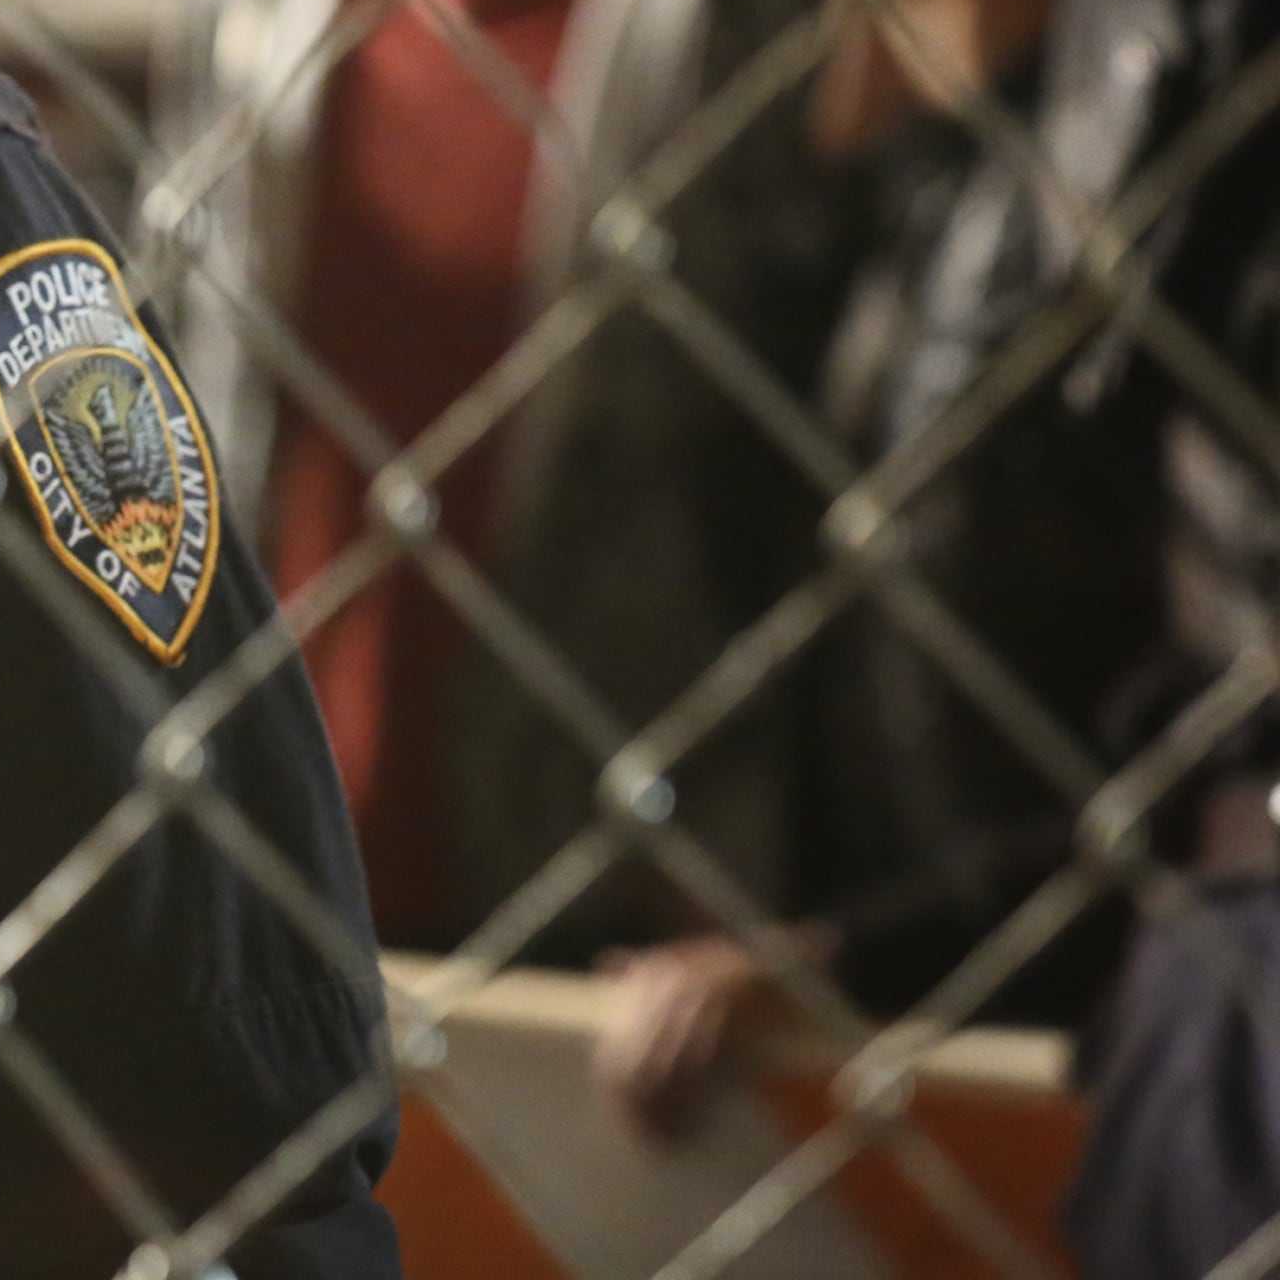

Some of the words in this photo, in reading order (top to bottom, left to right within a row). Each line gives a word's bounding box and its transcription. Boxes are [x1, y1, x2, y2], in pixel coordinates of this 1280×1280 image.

[6, 261, 110, 326] POLICE
[30, 452, 92, 548] CITY
[95, 549, 140, 596] OF
[169, 416, 208, 602] ATLANTA
